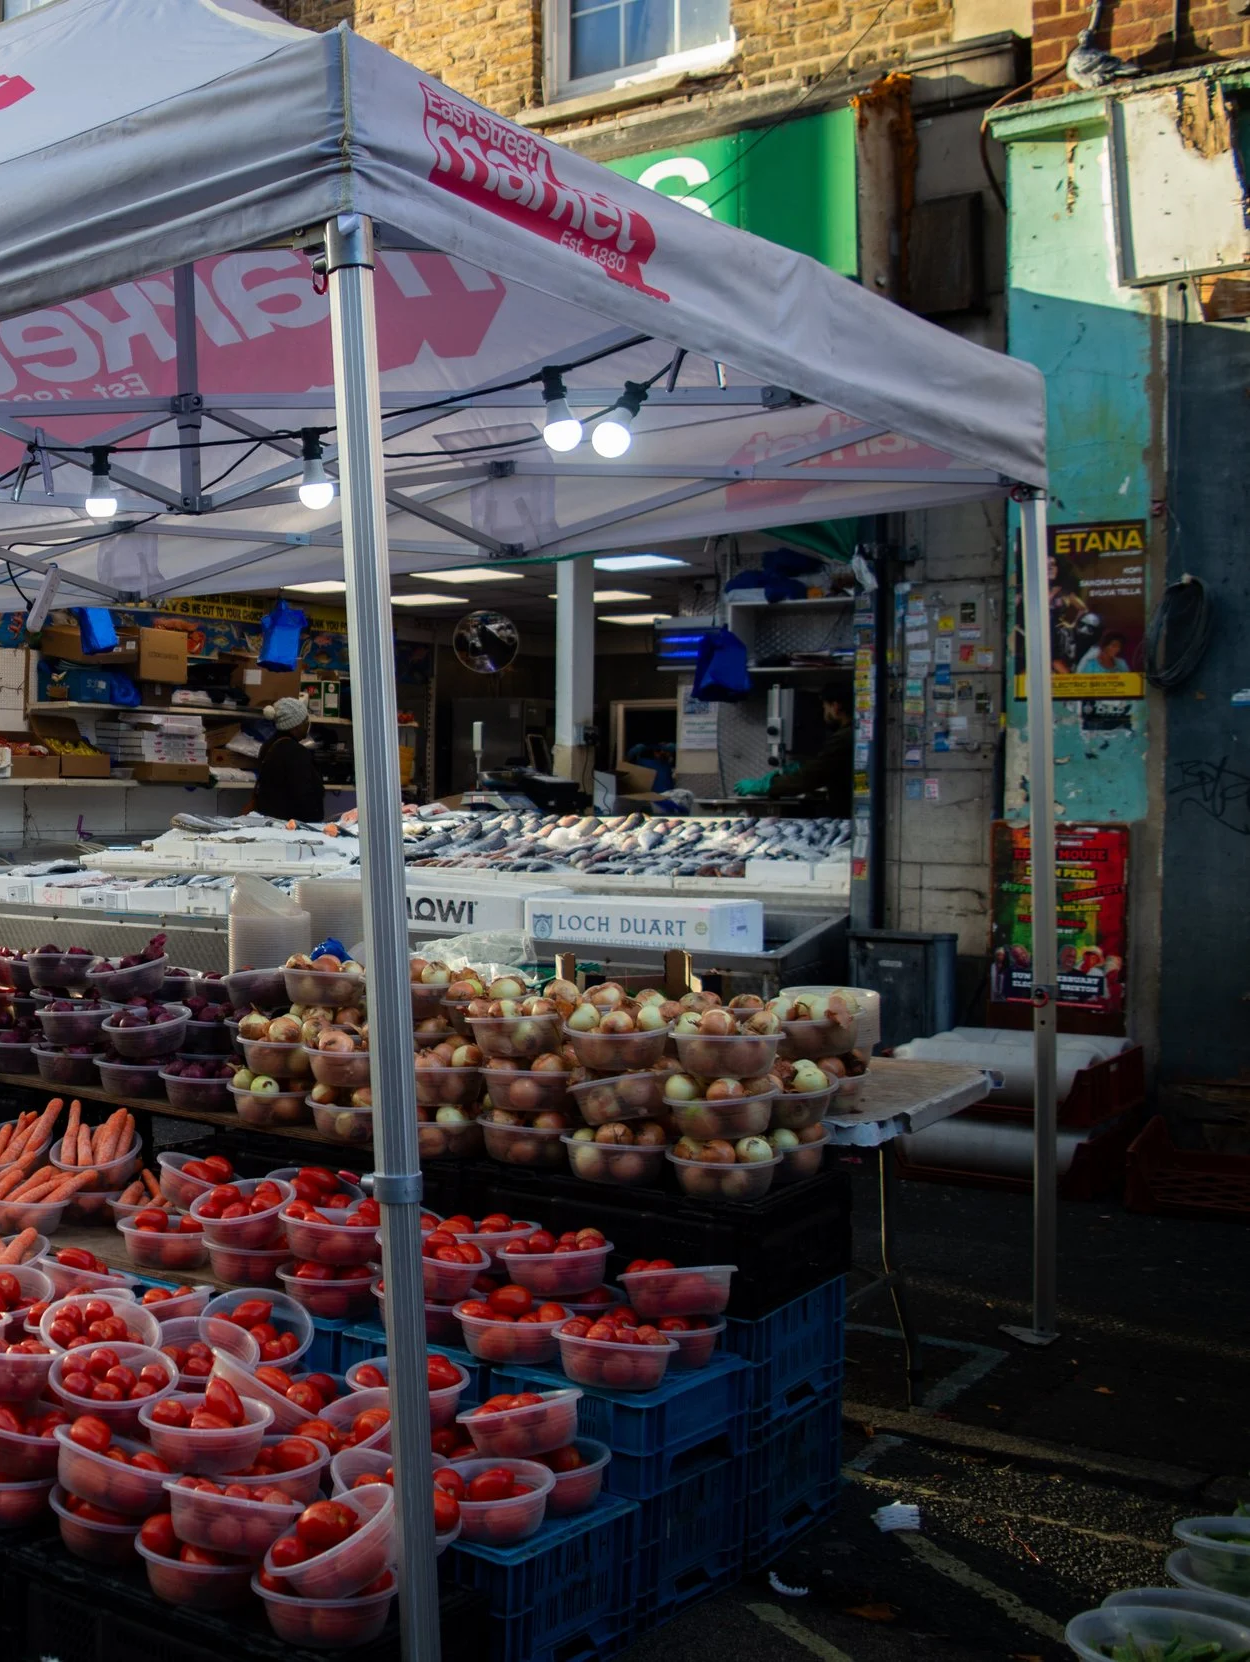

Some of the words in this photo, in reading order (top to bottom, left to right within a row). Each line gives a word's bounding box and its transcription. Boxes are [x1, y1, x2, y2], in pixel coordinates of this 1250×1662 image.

[427, 92, 474, 133] East
[475, 114, 540, 169] Street
[426, 117, 637, 254] market
[590, 244, 627, 273] 1880
[1055, 529, 1143, 555] ETANA
[1059, 850, 1106, 860] MOUSE
[406, 896, 474, 925] OWI
[558, 914, 610, 933] LOCH
[620, 917, 687, 937] DUART
